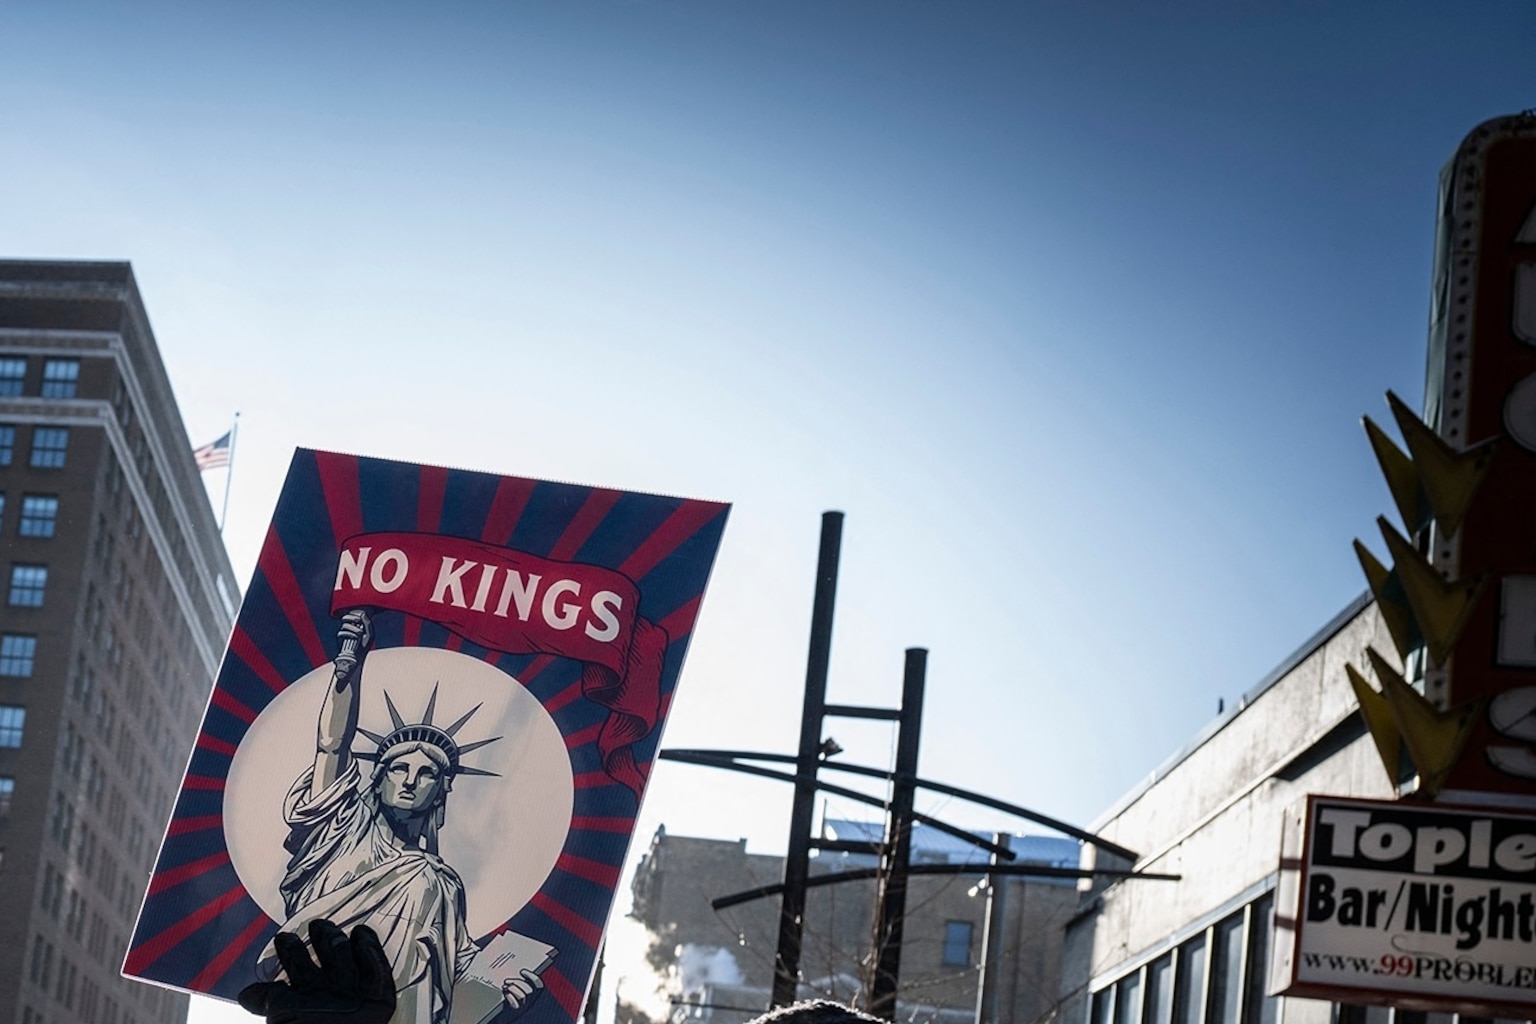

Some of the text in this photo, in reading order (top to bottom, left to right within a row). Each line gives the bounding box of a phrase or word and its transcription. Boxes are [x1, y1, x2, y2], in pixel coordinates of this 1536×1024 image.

[334, 545, 624, 644] NO KINGS
[1306, 872, 1536, 952] Bar/Night
[1304, 953, 1536, 990] www.99PROBLE
